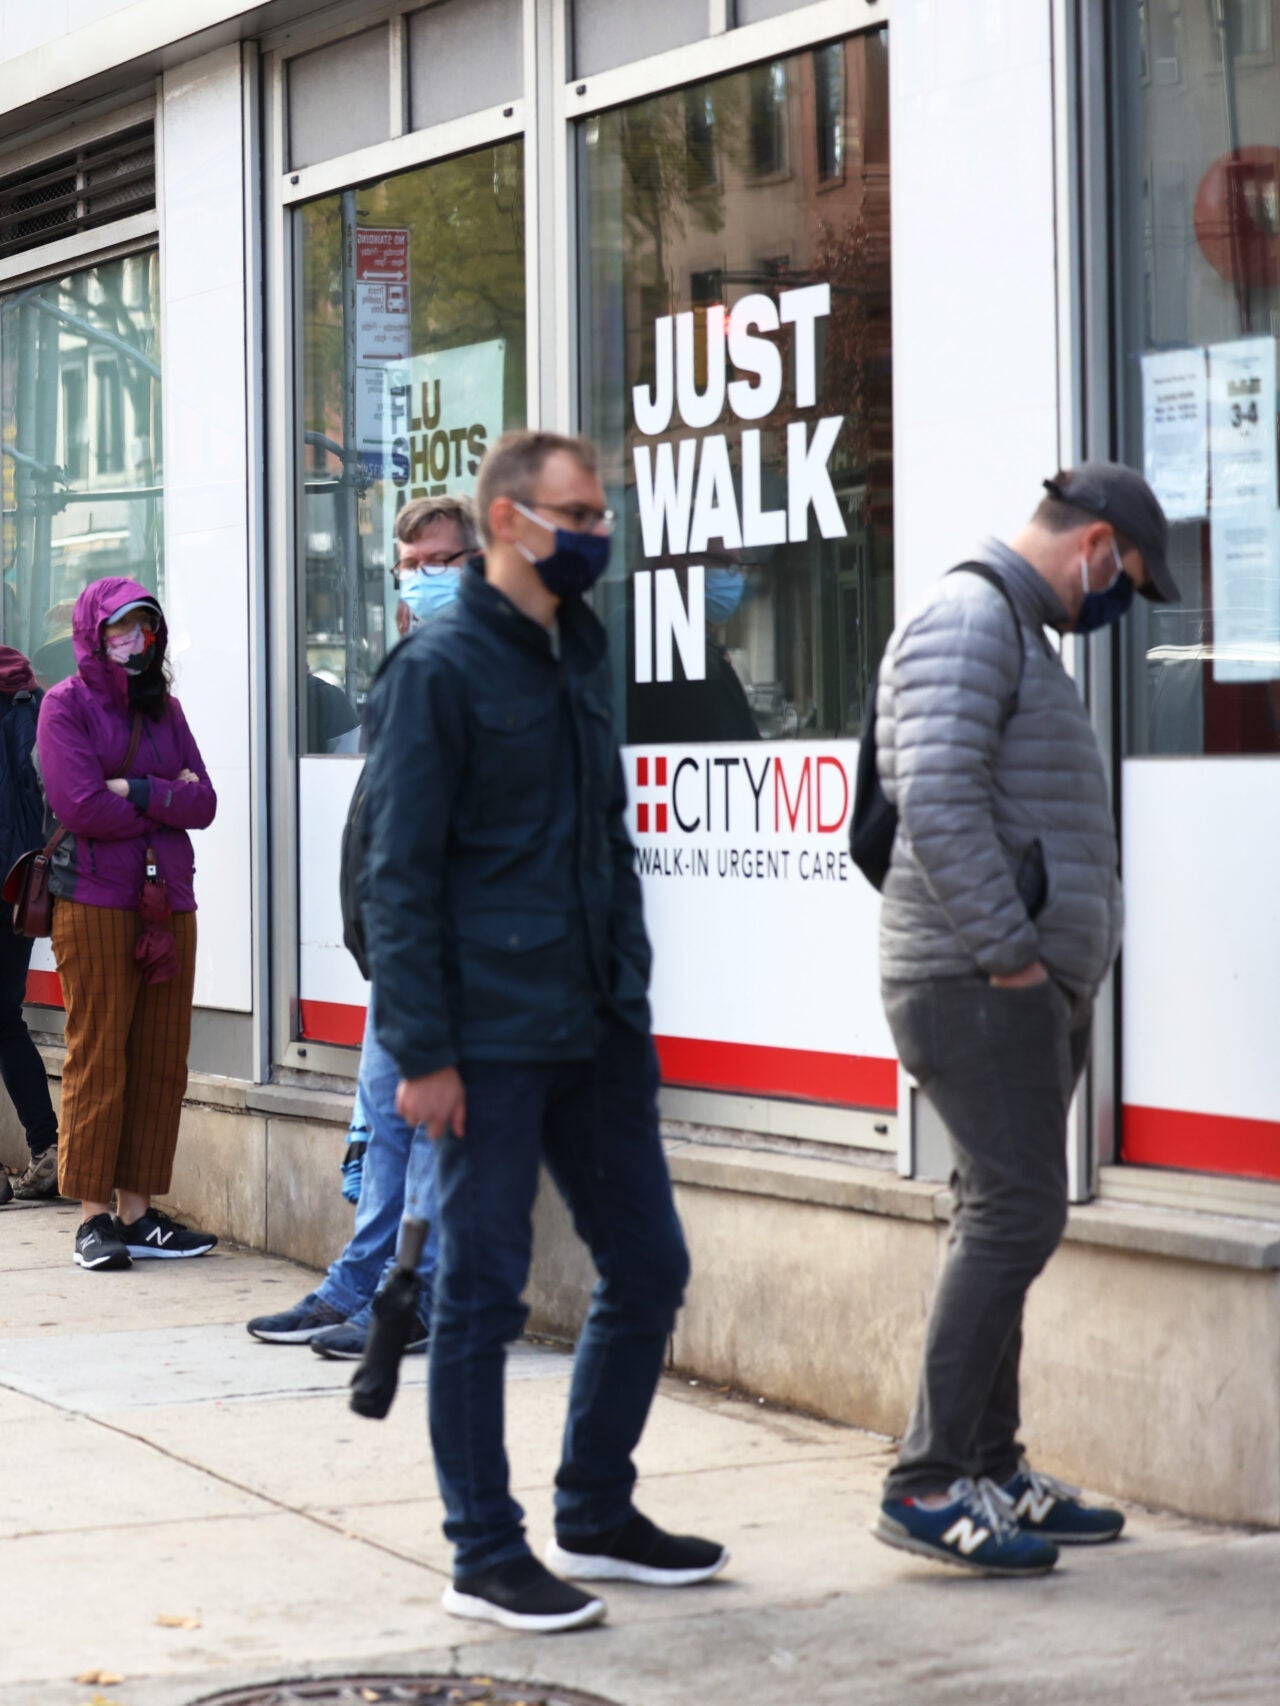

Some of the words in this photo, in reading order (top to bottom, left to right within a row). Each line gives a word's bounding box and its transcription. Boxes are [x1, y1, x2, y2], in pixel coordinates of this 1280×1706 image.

[632, 283, 831, 436] JUST
[390, 379, 441, 434] FLU
[392, 423, 488, 487] SHOTS
[633, 415, 847, 558] WALK
[634, 565, 707, 684] IN
[672, 756, 849, 834] CITYMD
[634, 847, 709, 876] WALK-IN
[716, 848, 790, 879] URGENT
[798, 850, 848, 881] CARE
[940, 1515, 991, 1556] N
